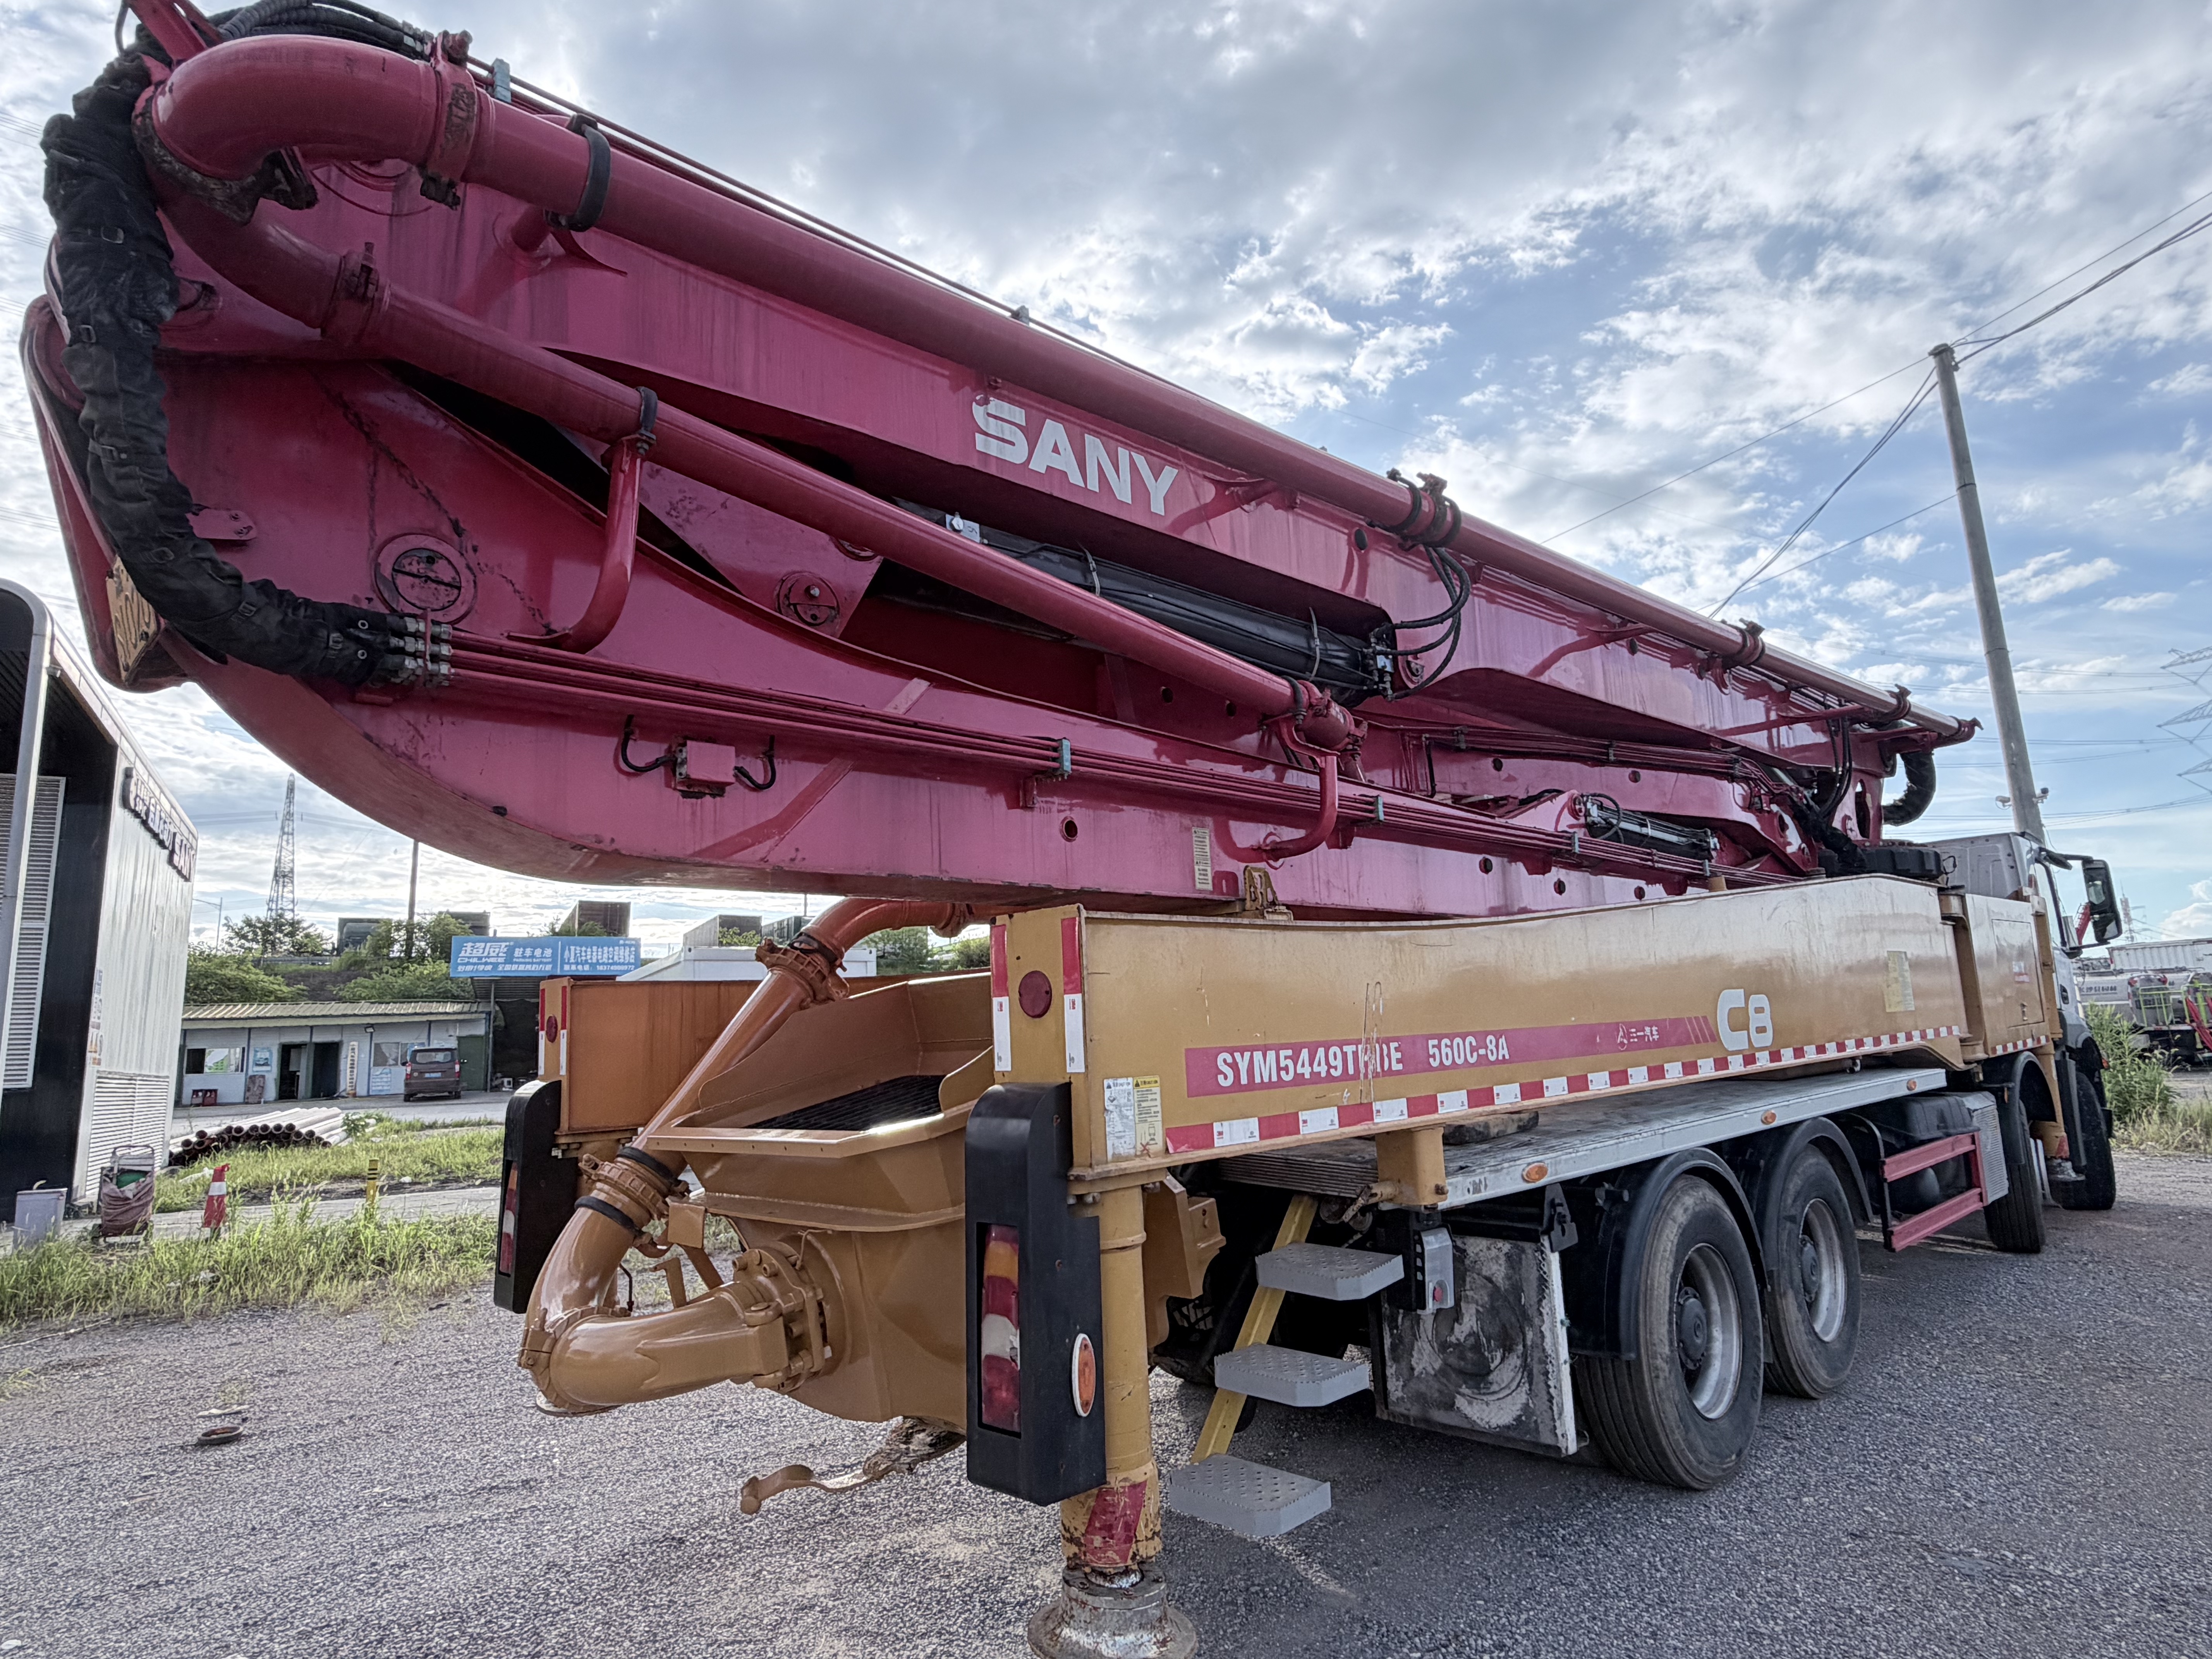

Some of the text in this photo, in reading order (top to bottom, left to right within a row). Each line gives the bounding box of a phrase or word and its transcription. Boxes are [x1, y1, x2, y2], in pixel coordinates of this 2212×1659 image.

[972, 394, 1178, 516] SANY
[459, 942, 510, 957] 超威
[514, 947, 552, 957] 驻车电池
[1717, 988, 1774, 1051] C8
[1629, 1025, 1659, 1042] 三一汽车
[1428, 1035, 1510, 1068] 560C-8A
